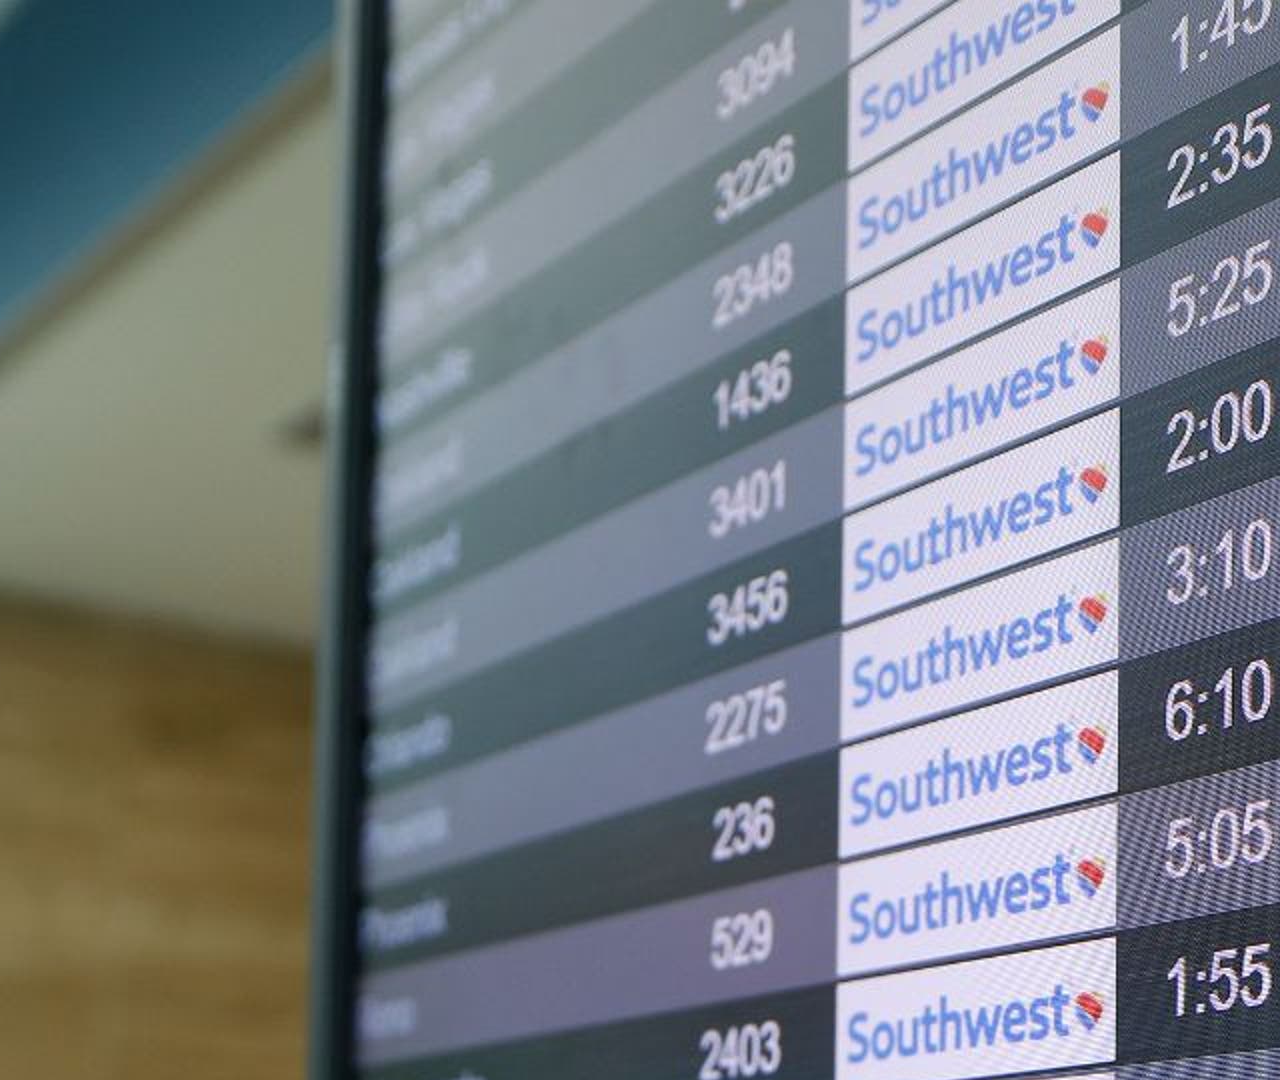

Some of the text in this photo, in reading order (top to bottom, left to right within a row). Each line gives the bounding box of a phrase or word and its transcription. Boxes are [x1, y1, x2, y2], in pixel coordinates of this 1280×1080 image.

[715, 133, 796, 222] 3226
[718, 30, 795, 118] 3094
[713, 242, 793, 327] 2348
[858, 91, 1075, 249] Southwest
[713, 348, 793, 428] 1436
[857, 213, 1075, 363] Southwest
[1166, 103, 1274, 209] 2:35
[709, 460, 786, 537] 3401
[855, 340, 1075, 476] Southwest
[1166, 241, 1273, 338] 5:25
[706, 568, 790, 646] 3456
[853, 466, 1075, 592] Southwest
[1166, 378, 1273, 474] 2:00
[705, 679, 787, 754] 2275
[851, 593, 1074, 708] Southwest
[1166, 518, 1273, 604] 3:10
[711, 795, 776, 862] 236
[849, 722, 1073, 826] Southwest
[1164, 658, 1272, 742] 6:10
[710, 908, 774, 970] 529
[848, 853, 1071, 945] Southwest
[1165, 800, 1273, 878] 5:05
[847, 984, 1070, 1063] Southwest
[1166, 942, 1273, 1018] 1:55
